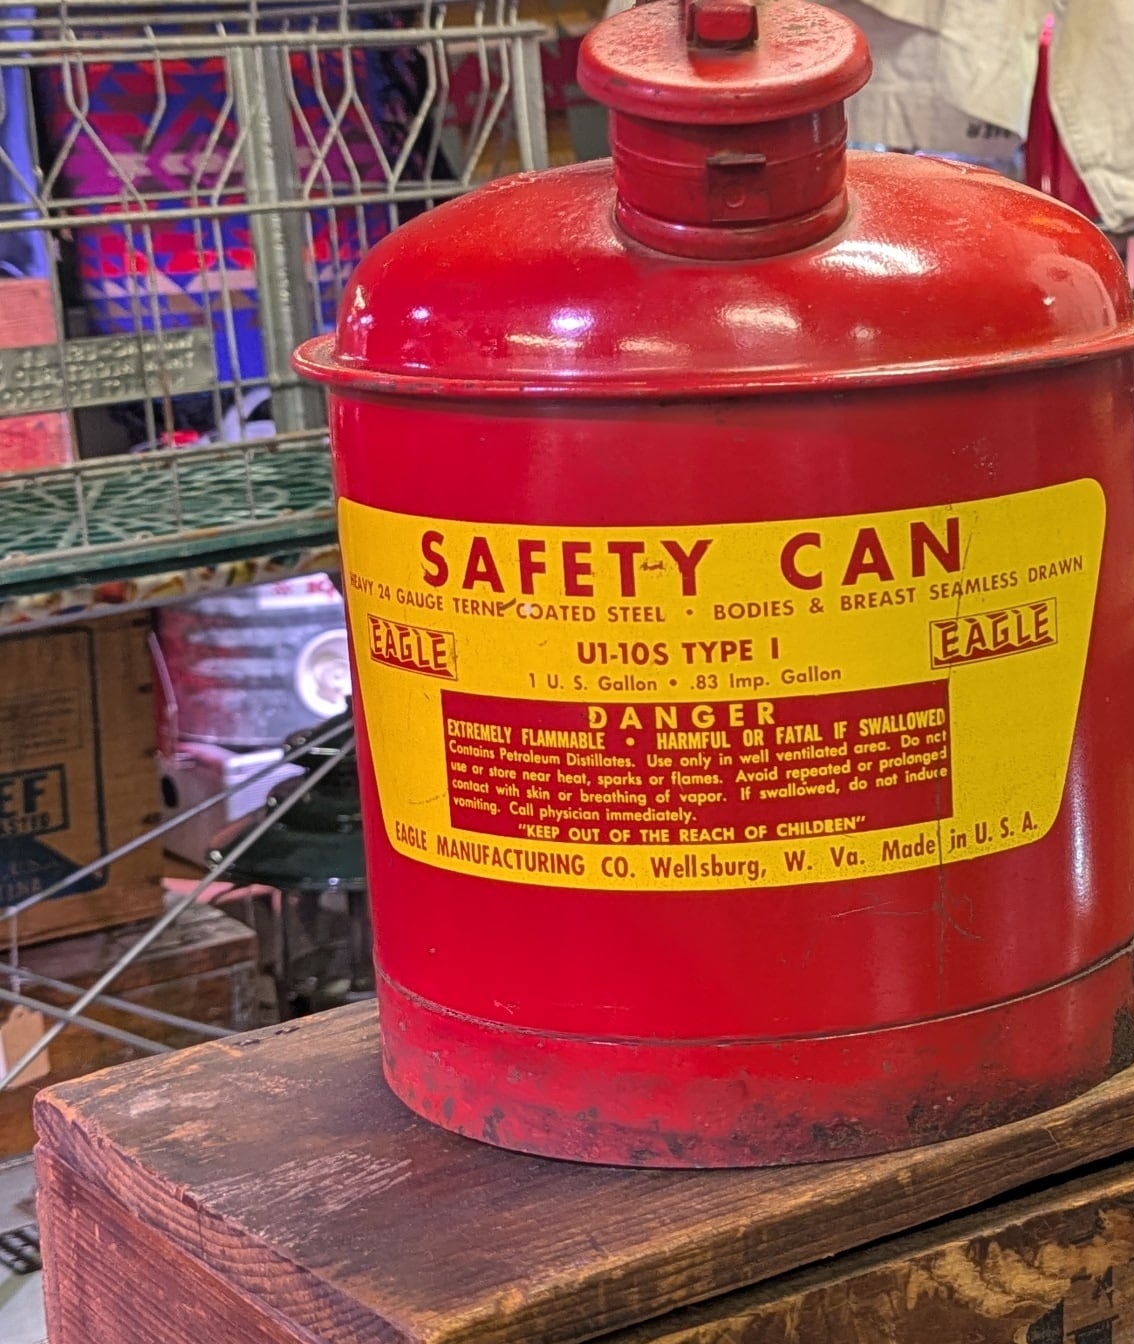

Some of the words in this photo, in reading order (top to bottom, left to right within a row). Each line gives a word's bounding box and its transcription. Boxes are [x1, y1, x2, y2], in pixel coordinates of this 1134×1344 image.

[421, 530, 713, 597] SAFETY
[780, 517, 960, 590] CAN
[350, 573, 374, 596] HEAVY
[378, 584, 392, 601] 24
[396, 588, 444, 611] GAUGE
[516, 603, 596, 623] COATED
[608, 607, 665, 623] STEEL
[714, 600, 794, 621] BODIES
[809, 598, 825, 615] &
[840, 587, 917, 612] BREAST
[929, 572, 1018, 601] SEAMLESS
[1028, 556, 1084, 584] DRAWN
[369, 617, 452, 676] EAGLE
[682, 639, 752, 666] TYPE
[935, 602, 1053, 664] EAGLE
[529, 673, 536, 688] 1
[547, 674, 564, 689] U.
[574, 674, 588, 690] S.
[598, 674, 658, 692] Gallon
[690, 673, 718, 690] .83
[730, 672, 770, 691] Imp.
[780, 665, 842, 685] Gallon
[447, 719, 512, 745] EXTREMELY
[521, 728, 606, 750] FLAMMABLE
[656, 730, 731, 750] HARMFUL
[743, 728, 764, 748] OR
[776, 724, 823, 746] FATAL
[834, 721, 847, 740] IF
[859, 708, 945, 737] SWALLOWED
[588, 701, 775, 730] DANGER
[449, 740, 495, 760] Contains
[500, 748, 561, 766] Petroleum
[566, 753, 636, 768] Distillates.
[647, 754, 673, 768] Use
[680, 753, 711, 770] only
[719, 752, 732, 766] in
[739, 749, 769, 765] well
[776, 742, 848, 763] ventilated
[854, 741, 891, 755] area.
[901, 733, 920, 748] Do
[451, 760, 468, 774] use
[472, 764, 484, 776] or
[489, 764, 517, 780] store
[522, 770, 551, 783] near
[557, 770, 592, 787] heat,
[598, 773, 643, 787] sparks
[649, 774, 664, 786] or
[671, 770, 723, 786] flames.
[735, 766, 779, 783] Avoid
[786, 759, 851, 783] repeated
[858, 760, 873, 772] or
[879, 747, 947, 770] prolonged
[452, 778, 490, 794] contact
[496, 783, 520, 798] with
[526, 785, 550, 801] skin
[558, 790, 573, 802] or
[580, 790, 647, 806] breathing
[655, 789, 670, 803] of
[679, 791, 727, 808] vapor.
[741, 786, 751, 800] If
[760, 783, 841, 801] swallowed,
[849, 777, 868, 792] do
[876, 773, 898, 788] not
[905, 765, 948, 783] induce
[453, 795, 501, 816] vomiting.
[509, 801, 534, 817] Call
[539, 804, 600, 822] physician
[605, 807, 697, 824] immediately.
[395, 821, 428, 852] EAGLE
[437, 834, 585, 877] MANUFACTURING
[601, 856, 636, 878] CO.
[650, 853, 767, 881] Wellsburg,
[784, 850, 813, 872] W.
[830, 846, 865, 868] Va.
[882, 833, 936, 862] Made
[950, 828, 967, 851] in
[975, 821, 993, 844] U.
[1000, 816, 1015, 839] S.
[1021, 811, 1038, 833] A.
[568, 828, 600, 842] OUT
[609, 829, 631, 843] OF
[639, 829, 670, 843] THE
[679, 826, 735, 843] REACH
[744, 825, 767, 840] OF
